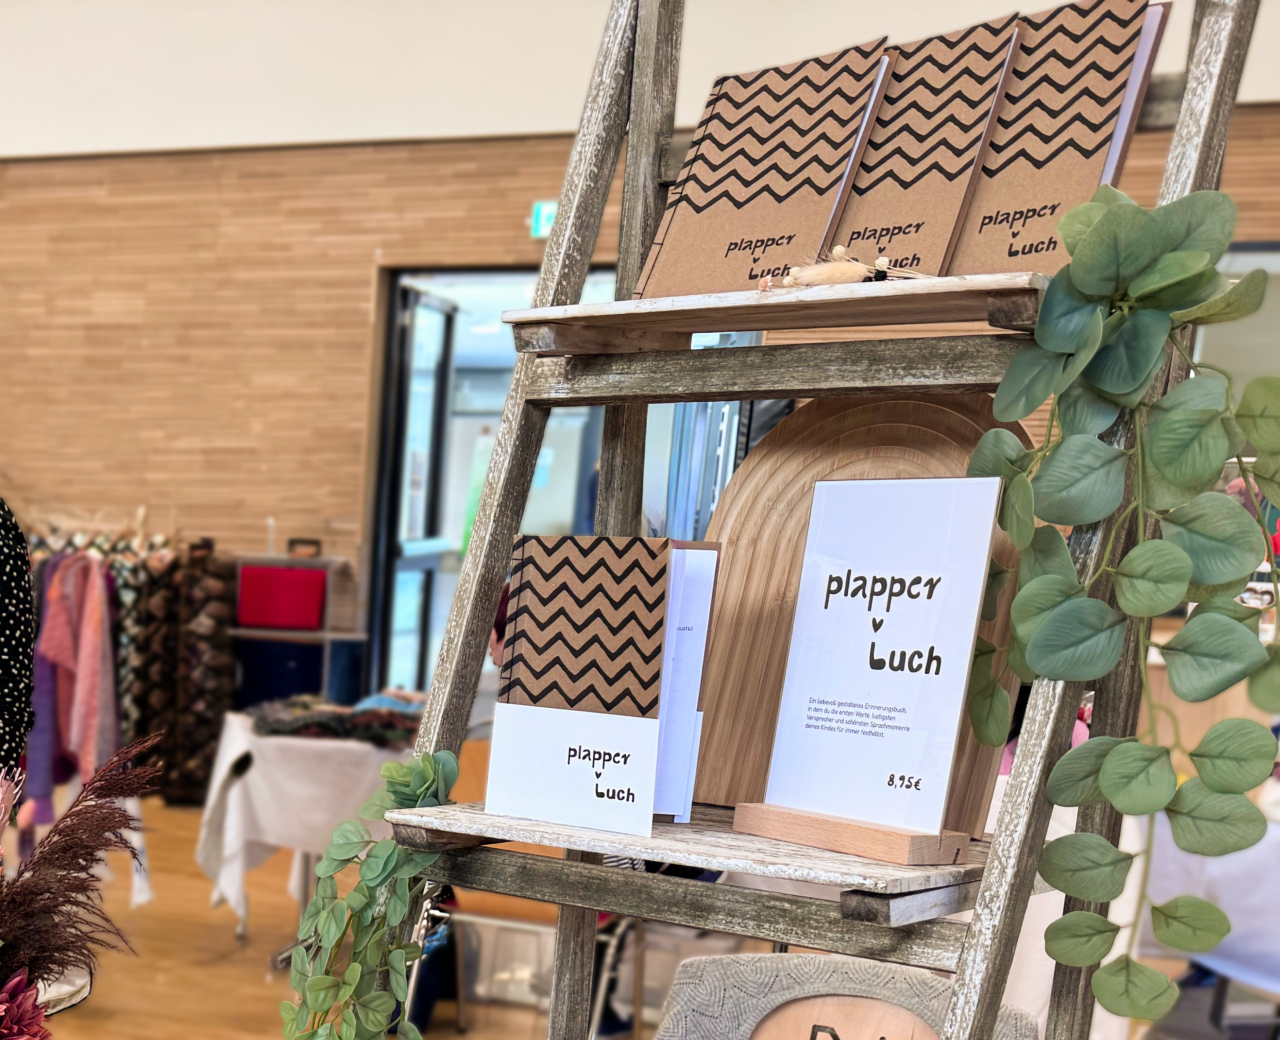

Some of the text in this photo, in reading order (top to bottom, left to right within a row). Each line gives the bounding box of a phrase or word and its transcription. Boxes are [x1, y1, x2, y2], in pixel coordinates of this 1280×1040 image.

[978, 202, 1062, 234] plapper
[724, 233, 797, 258] plapper
[847, 221, 925, 248] plapper
[1007, 236, 1058, 258] buch
[885, 253, 921, 271] uch
[824, 569, 942, 613] plapper
[869, 641, 942, 675] buch
[817, 698, 836, 706] liebevoll
[837, 701, 864, 709] gestaltetes
[567, 745, 630, 770] plapper
[595, 783, 635, 803] buch
[887, 774, 922, 791] 8,95€
